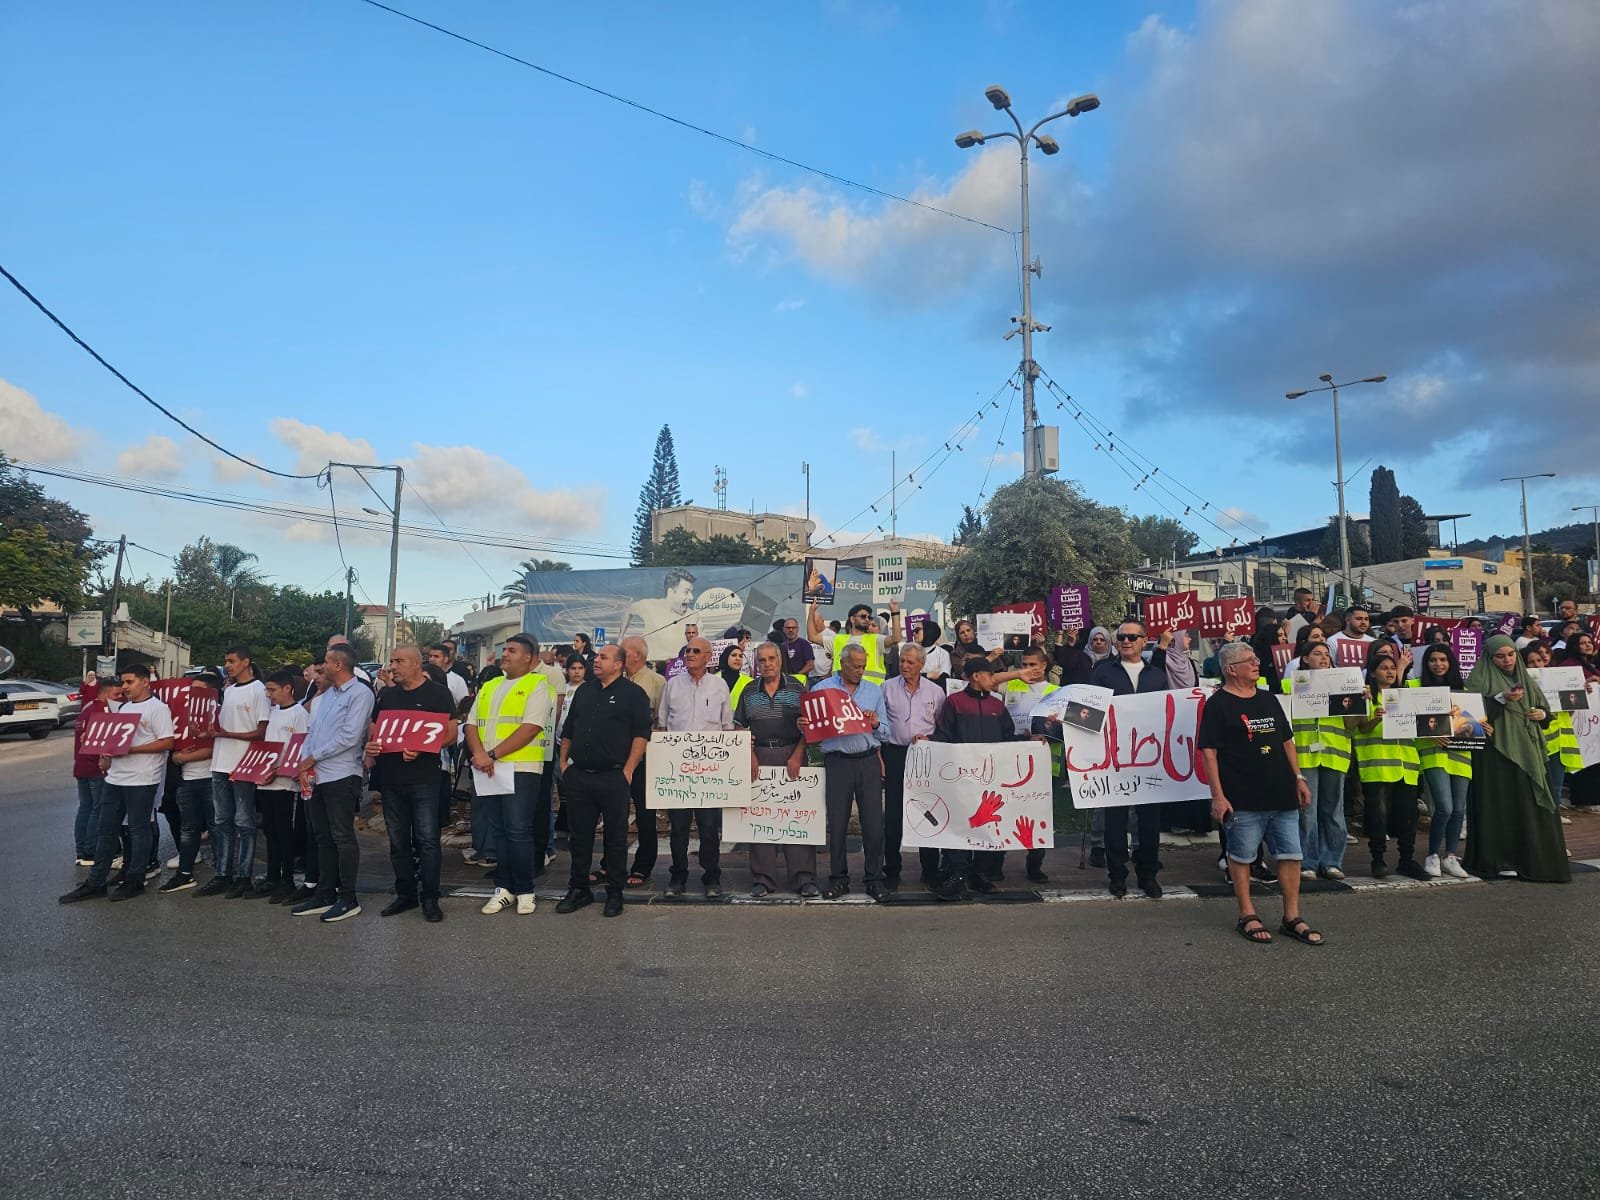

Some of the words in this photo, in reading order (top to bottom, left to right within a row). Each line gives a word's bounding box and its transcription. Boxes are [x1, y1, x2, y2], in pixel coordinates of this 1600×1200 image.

[878, 556, 902, 570] בטחון
[878, 571, 903, 582] שווה
[1000, 753, 1034, 788] لا
